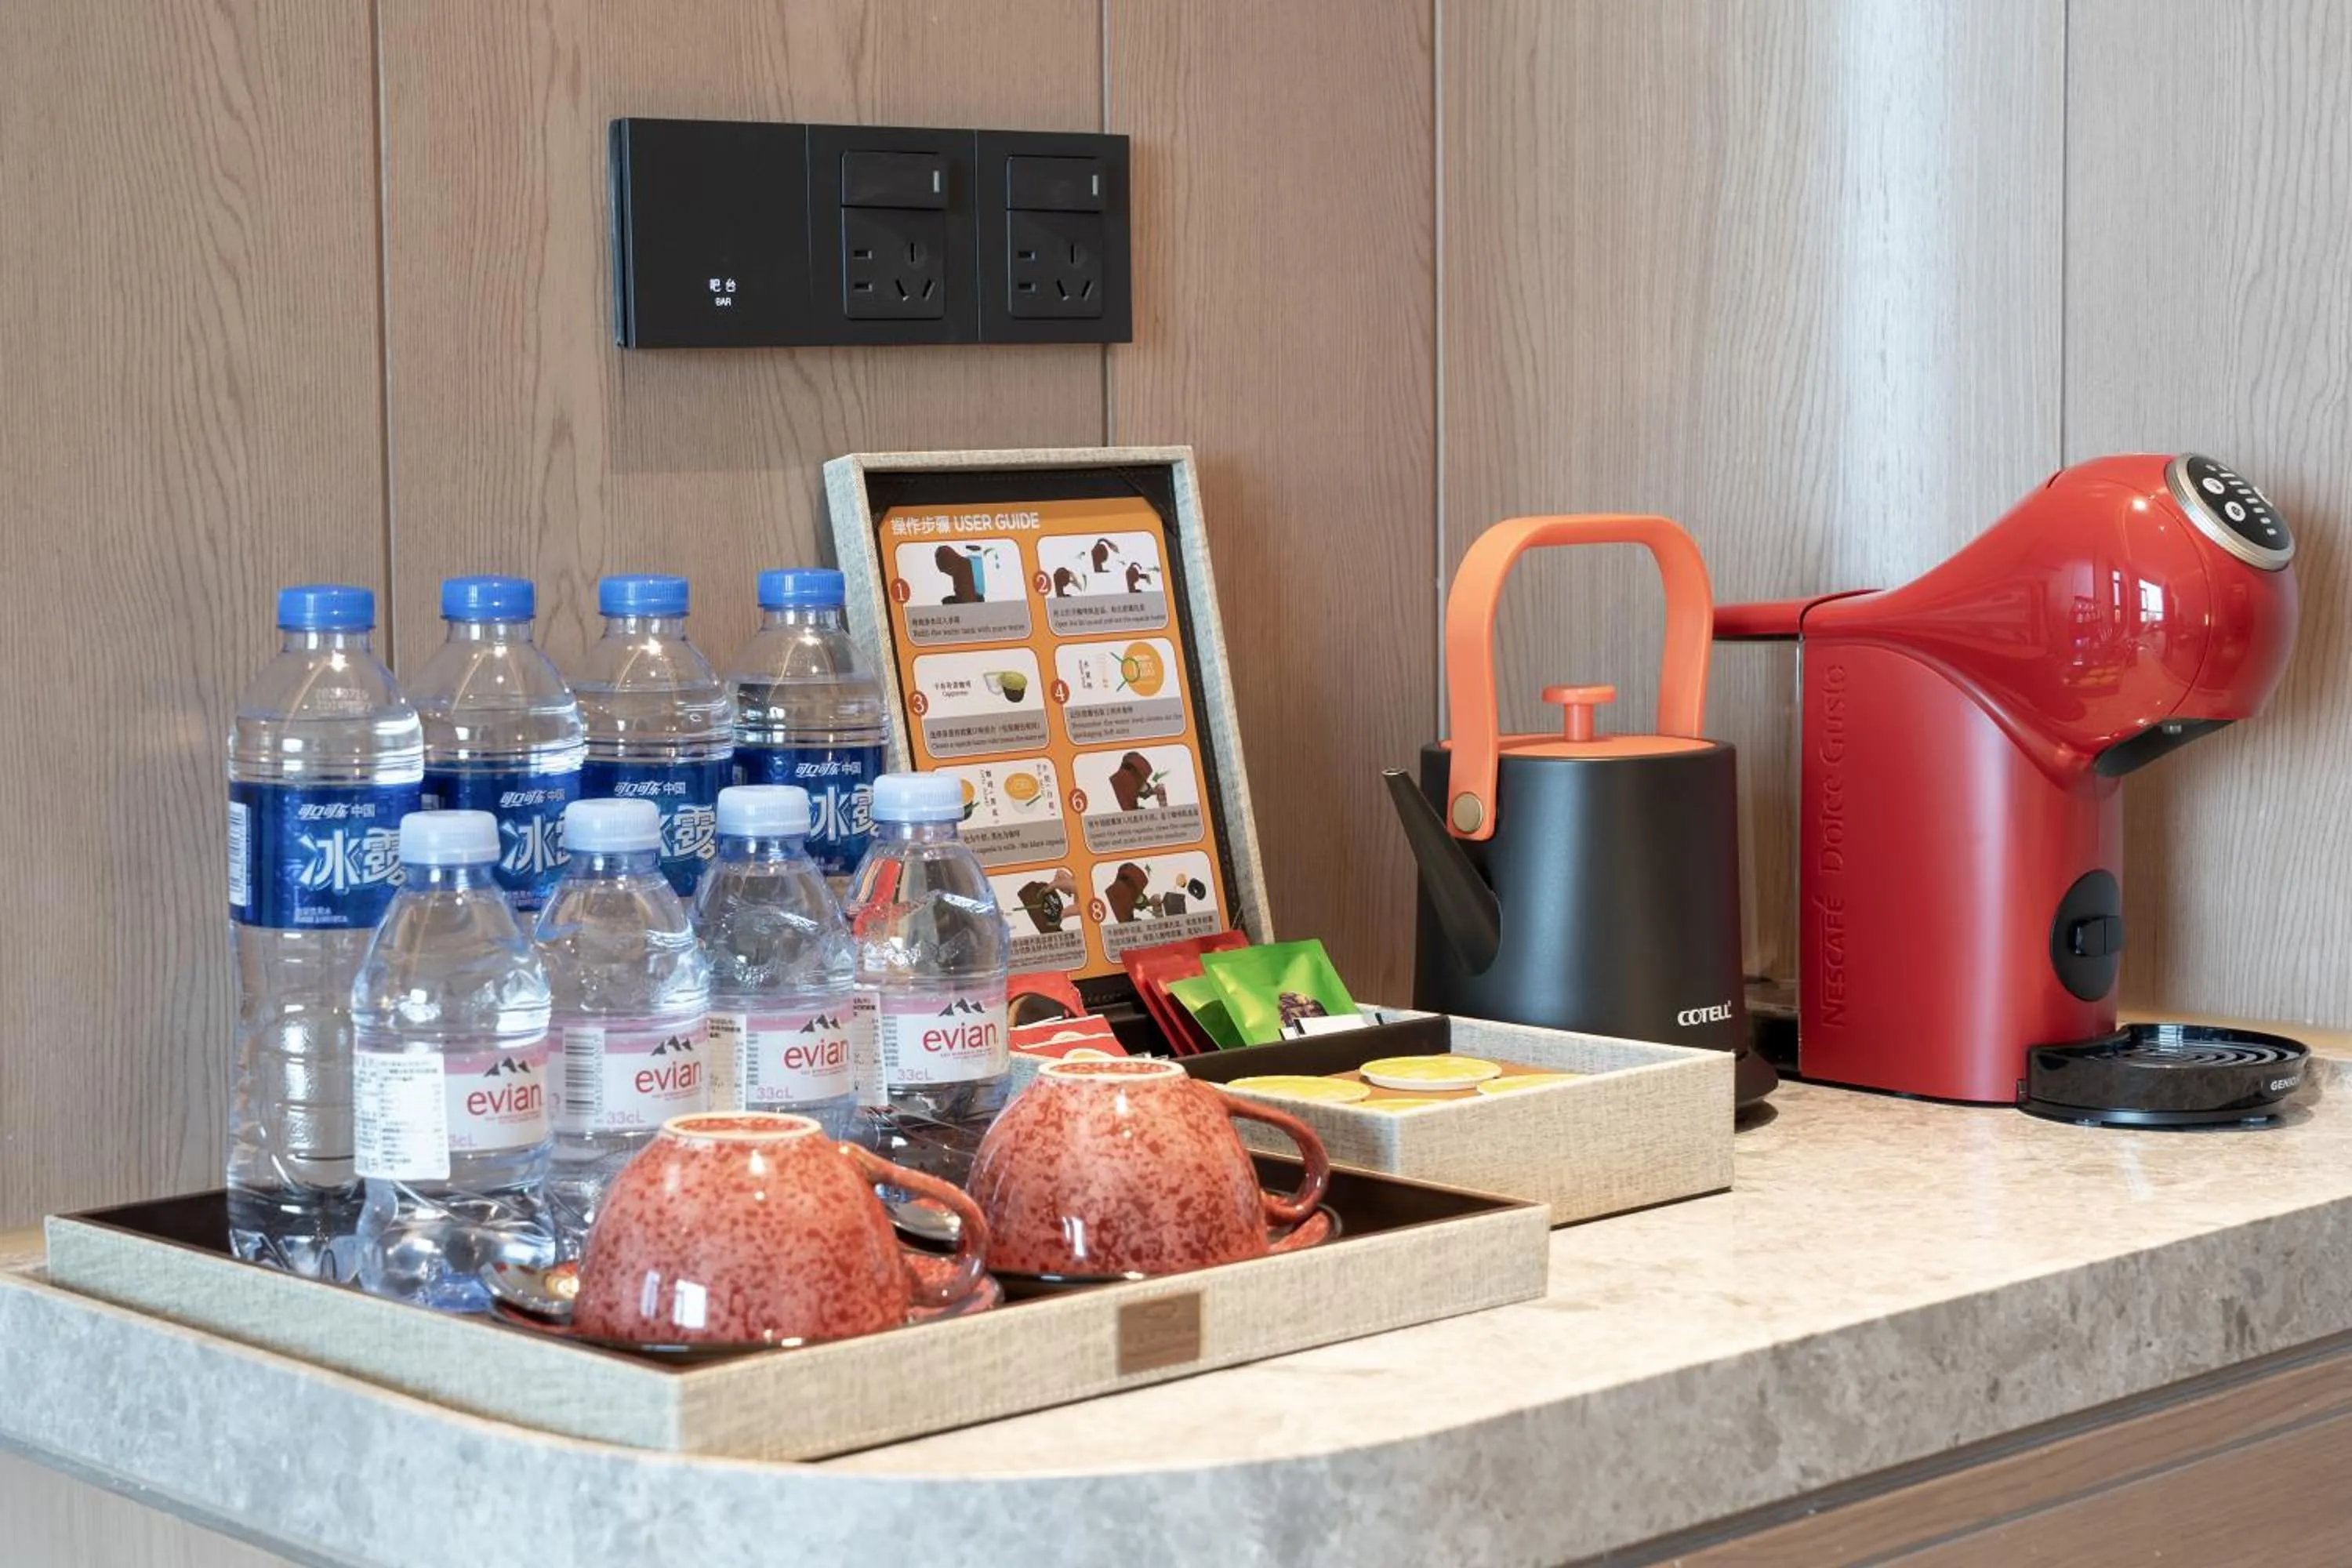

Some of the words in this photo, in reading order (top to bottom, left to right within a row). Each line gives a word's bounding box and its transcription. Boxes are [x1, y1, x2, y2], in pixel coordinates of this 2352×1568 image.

[710, 278, 736, 292] 吧台
[715, 297, 731, 307] BAR
[953, 514, 993, 532] USER
[995, 512, 1040, 529] GUIDE
[898, 583, 905, 601] 1
[1036, 575, 1048, 593] 2
[1056, 684, 1065, 702] 4
[913, 695, 924, 713] 3
[1072, 792, 1084, 812] 6
[1820, 775, 1846, 874] Dolce
[501, 815, 571, 873] 冰
[1092, 902, 1103, 920] 8
[1813, 893, 1847, 1028] NESCAFÉ
[1678, 1004, 1731, 1026] COTELL
[922, 1022, 997, 1052] evian
[783, 1038, 849, 1069] evian
[634, 1060, 702, 1094] evian
[897, 1069, 935, 1081] 33cL
[466, 1083, 543, 1116] evian
[606, 1110, 647, 1125] 33cL
